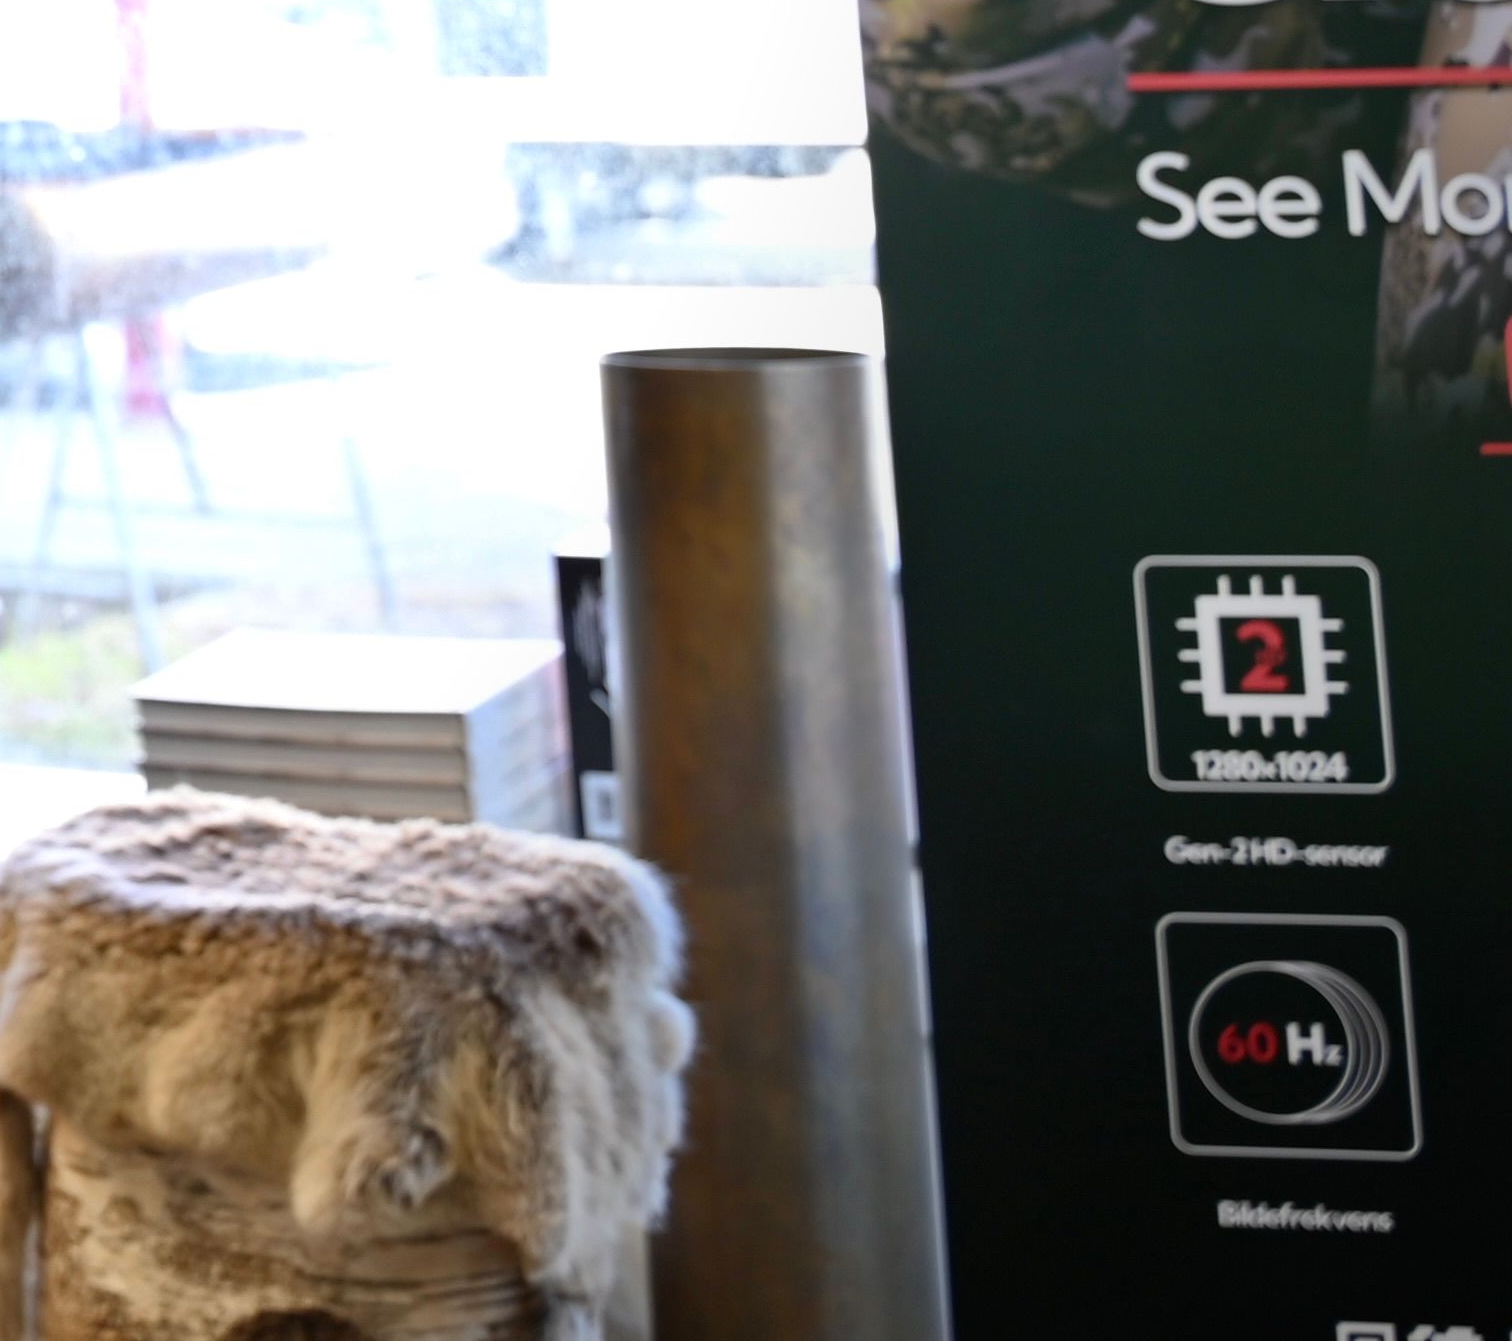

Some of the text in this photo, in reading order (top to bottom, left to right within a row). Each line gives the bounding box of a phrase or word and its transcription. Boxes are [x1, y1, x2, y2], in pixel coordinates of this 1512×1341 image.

[1136, 151, 1322, 240] See
[1237, 619, 1289, 692] 2
[1217, 1021, 1279, 1064] 60
